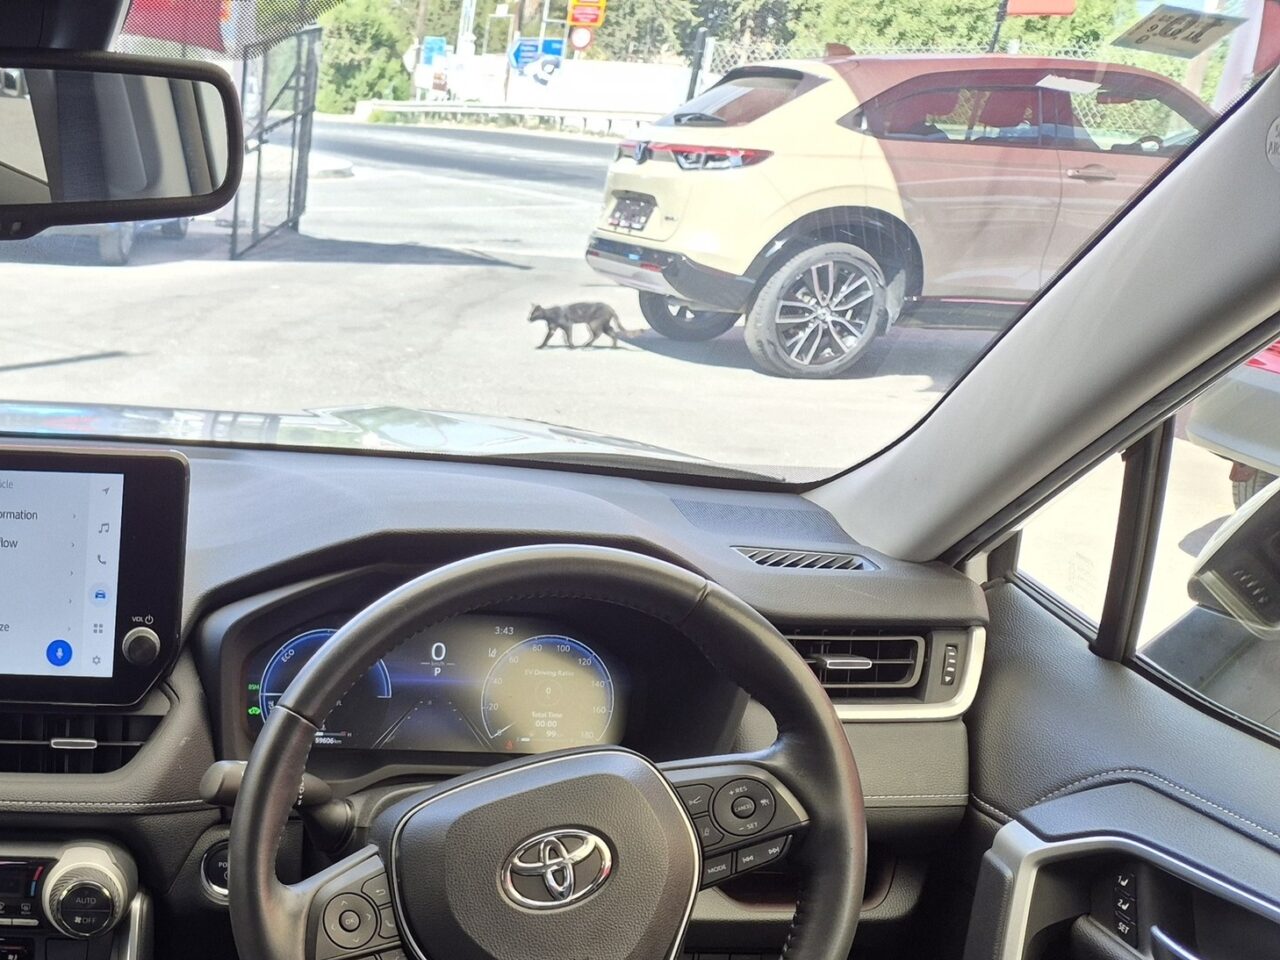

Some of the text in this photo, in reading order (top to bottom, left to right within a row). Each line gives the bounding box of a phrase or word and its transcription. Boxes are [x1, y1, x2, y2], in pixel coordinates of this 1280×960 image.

[494, 626, 514, 635] 3:43
[431, 642, 447, 661] 0
[556, 644, 571, 653] 100
[281, 648, 295, 663] ECO
[508, 655, 519, 663] 60
[578, 657, 592, 666] 120
[434, 667, 442, 677] P
[493, 677, 503, 685] 40
[592, 680, 605, 688] 140
[488, 703, 499, 711] 20
[593, 705, 607, 714] 160
[735, 786, 748, 794] RES
[746, 822, 758, 830] SET
[707, 863, 727, 873] MODE
[1117, 921, 1130, 935] SET
